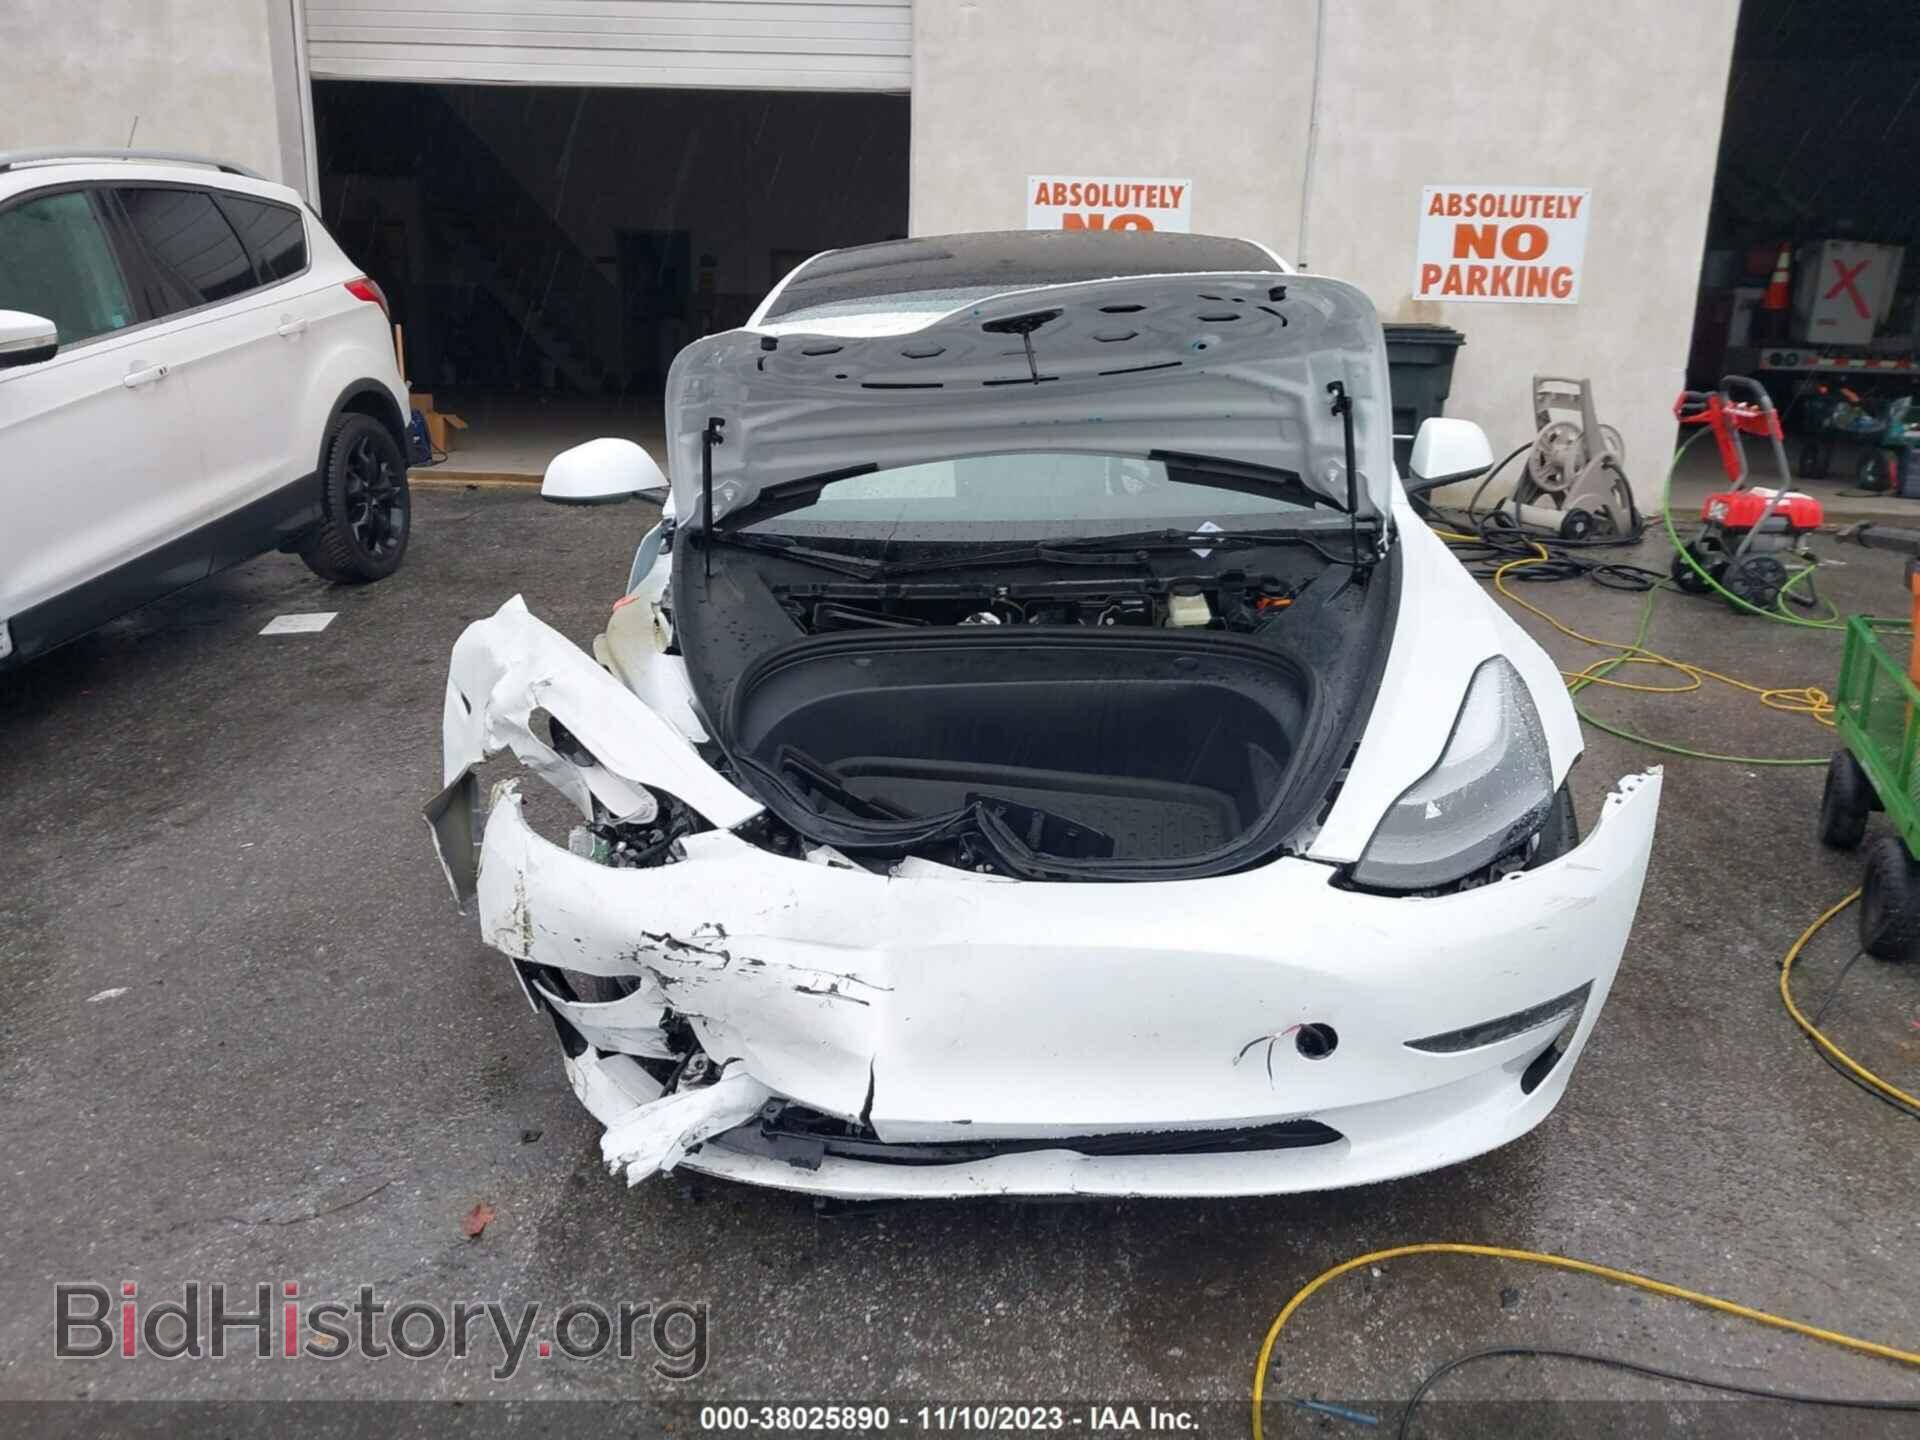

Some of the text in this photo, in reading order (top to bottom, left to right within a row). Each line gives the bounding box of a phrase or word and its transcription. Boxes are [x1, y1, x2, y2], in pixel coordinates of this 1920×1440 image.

[1034, 182, 1185, 208] ABSOLUTELY
[1428, 192, 1583, 219] ABSOLUTELY
[1453, 223, 1549, 261] NO
[1420, 263, 1574, 298] PARKING
